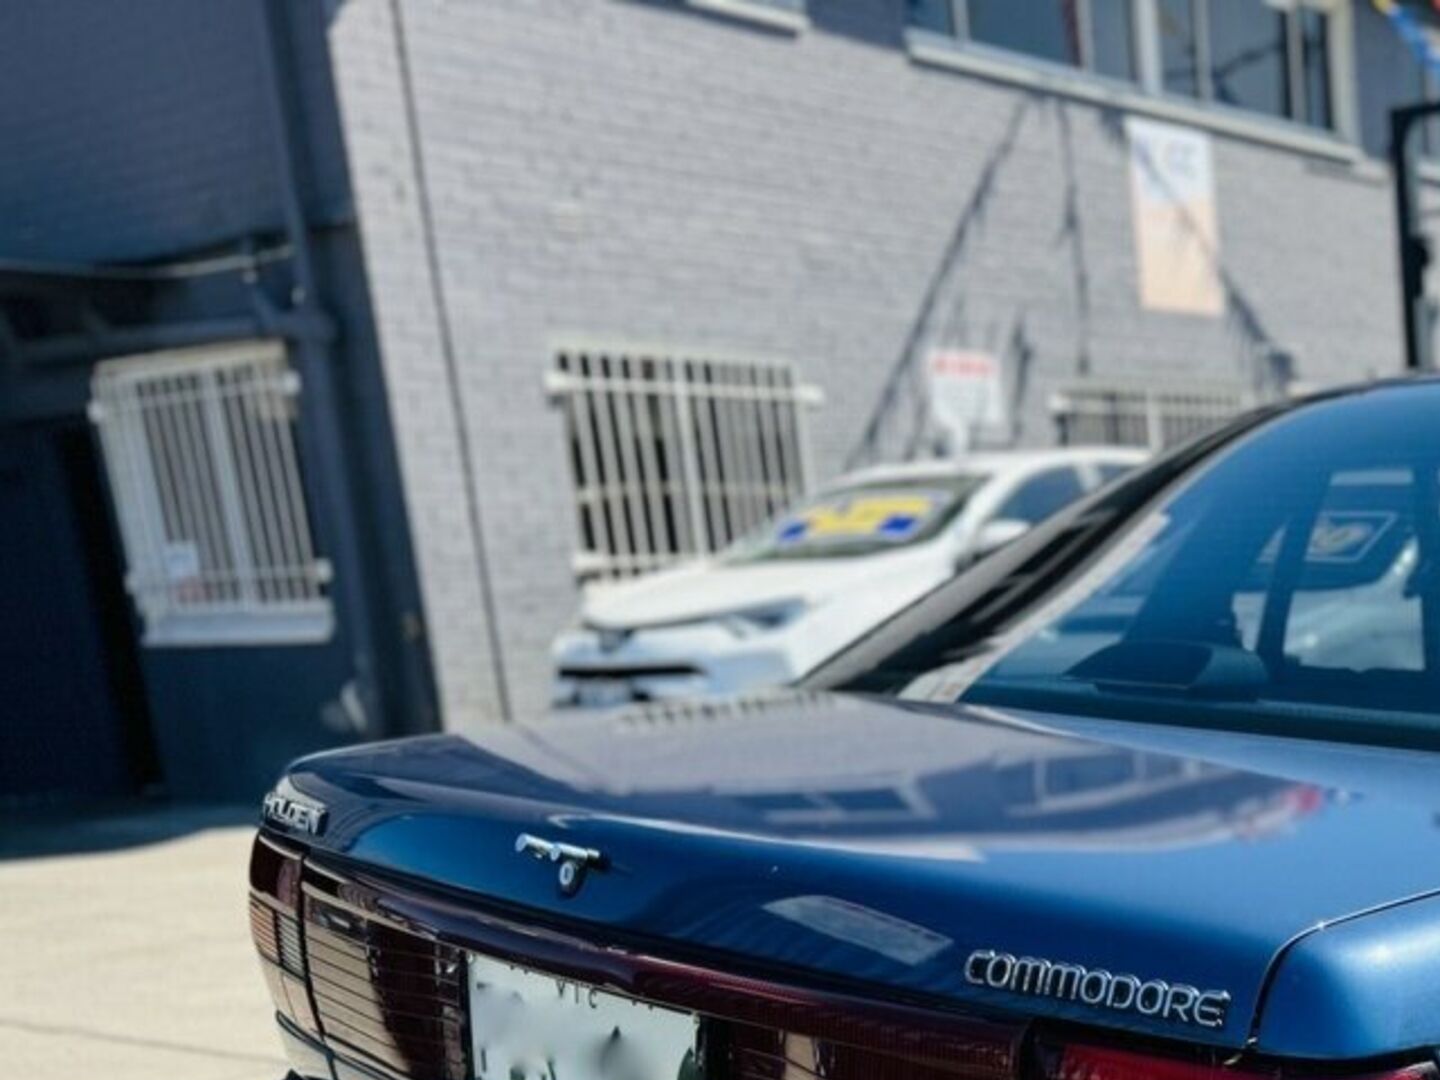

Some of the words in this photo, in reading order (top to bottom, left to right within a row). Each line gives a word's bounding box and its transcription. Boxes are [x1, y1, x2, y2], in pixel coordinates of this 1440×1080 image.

[262, 790, 327, 836] HOLDEN
[555, 979, 598, 1009] VIC
[964, 950, 1231, 1027] COMMODORE
